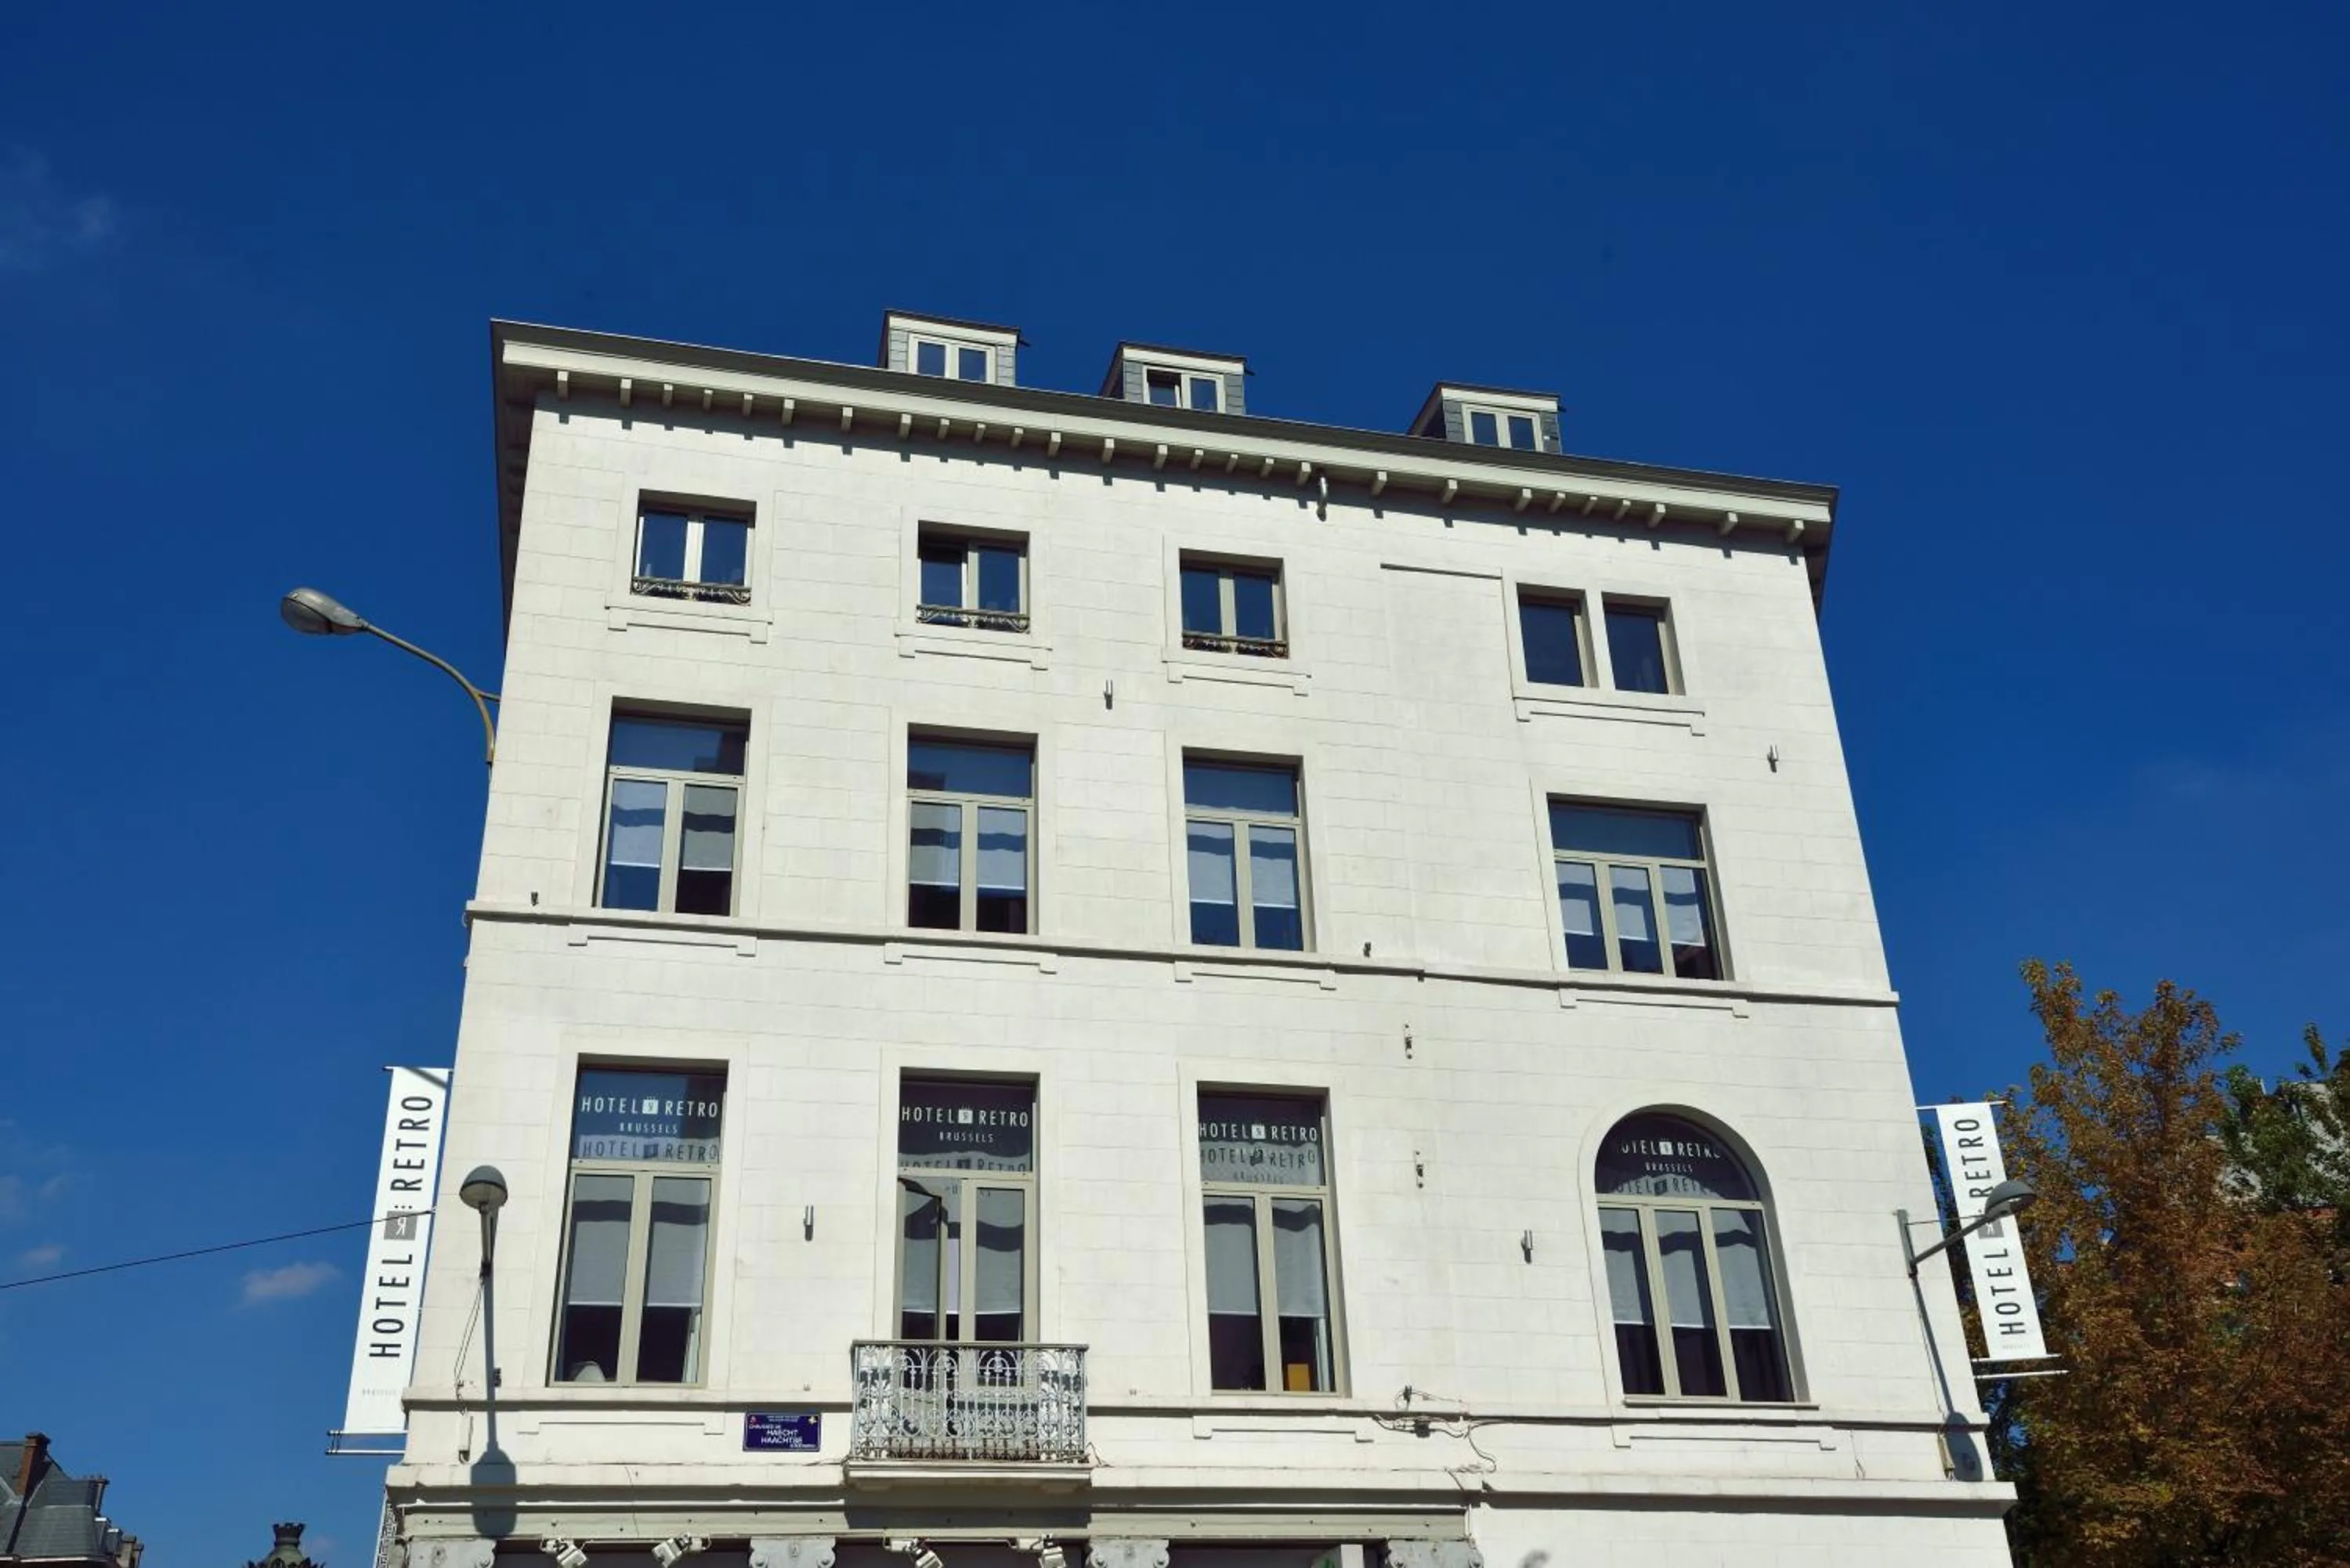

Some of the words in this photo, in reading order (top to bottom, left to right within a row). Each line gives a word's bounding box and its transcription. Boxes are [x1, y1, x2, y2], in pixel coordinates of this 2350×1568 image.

[581, 1097, 638, 1114] HOTEL
[665, 1100, 718, 1118] RETRO
[902, 1106, 955, 1124] HOTEL
[979, 1110, 1029, 1127] RETRO
[620, 1122, 678, 1133] BRUSSELS
[939, 1131, 994, 1143] BRUSSELS
[1199, 1122, 1249, 1139] HOTEL
[1271, 1125, 1318, 1142] RETRO
[390, 1096, 433, 1191] RETRO
[1644, 1162, 1694, 1173] BRUSSELS
[1954, 1118, 1994, 1198] RETRO
[1983, 1248, 2026, 1335] HOTEL
[369, 1254, 413, 1358] HOTEL
